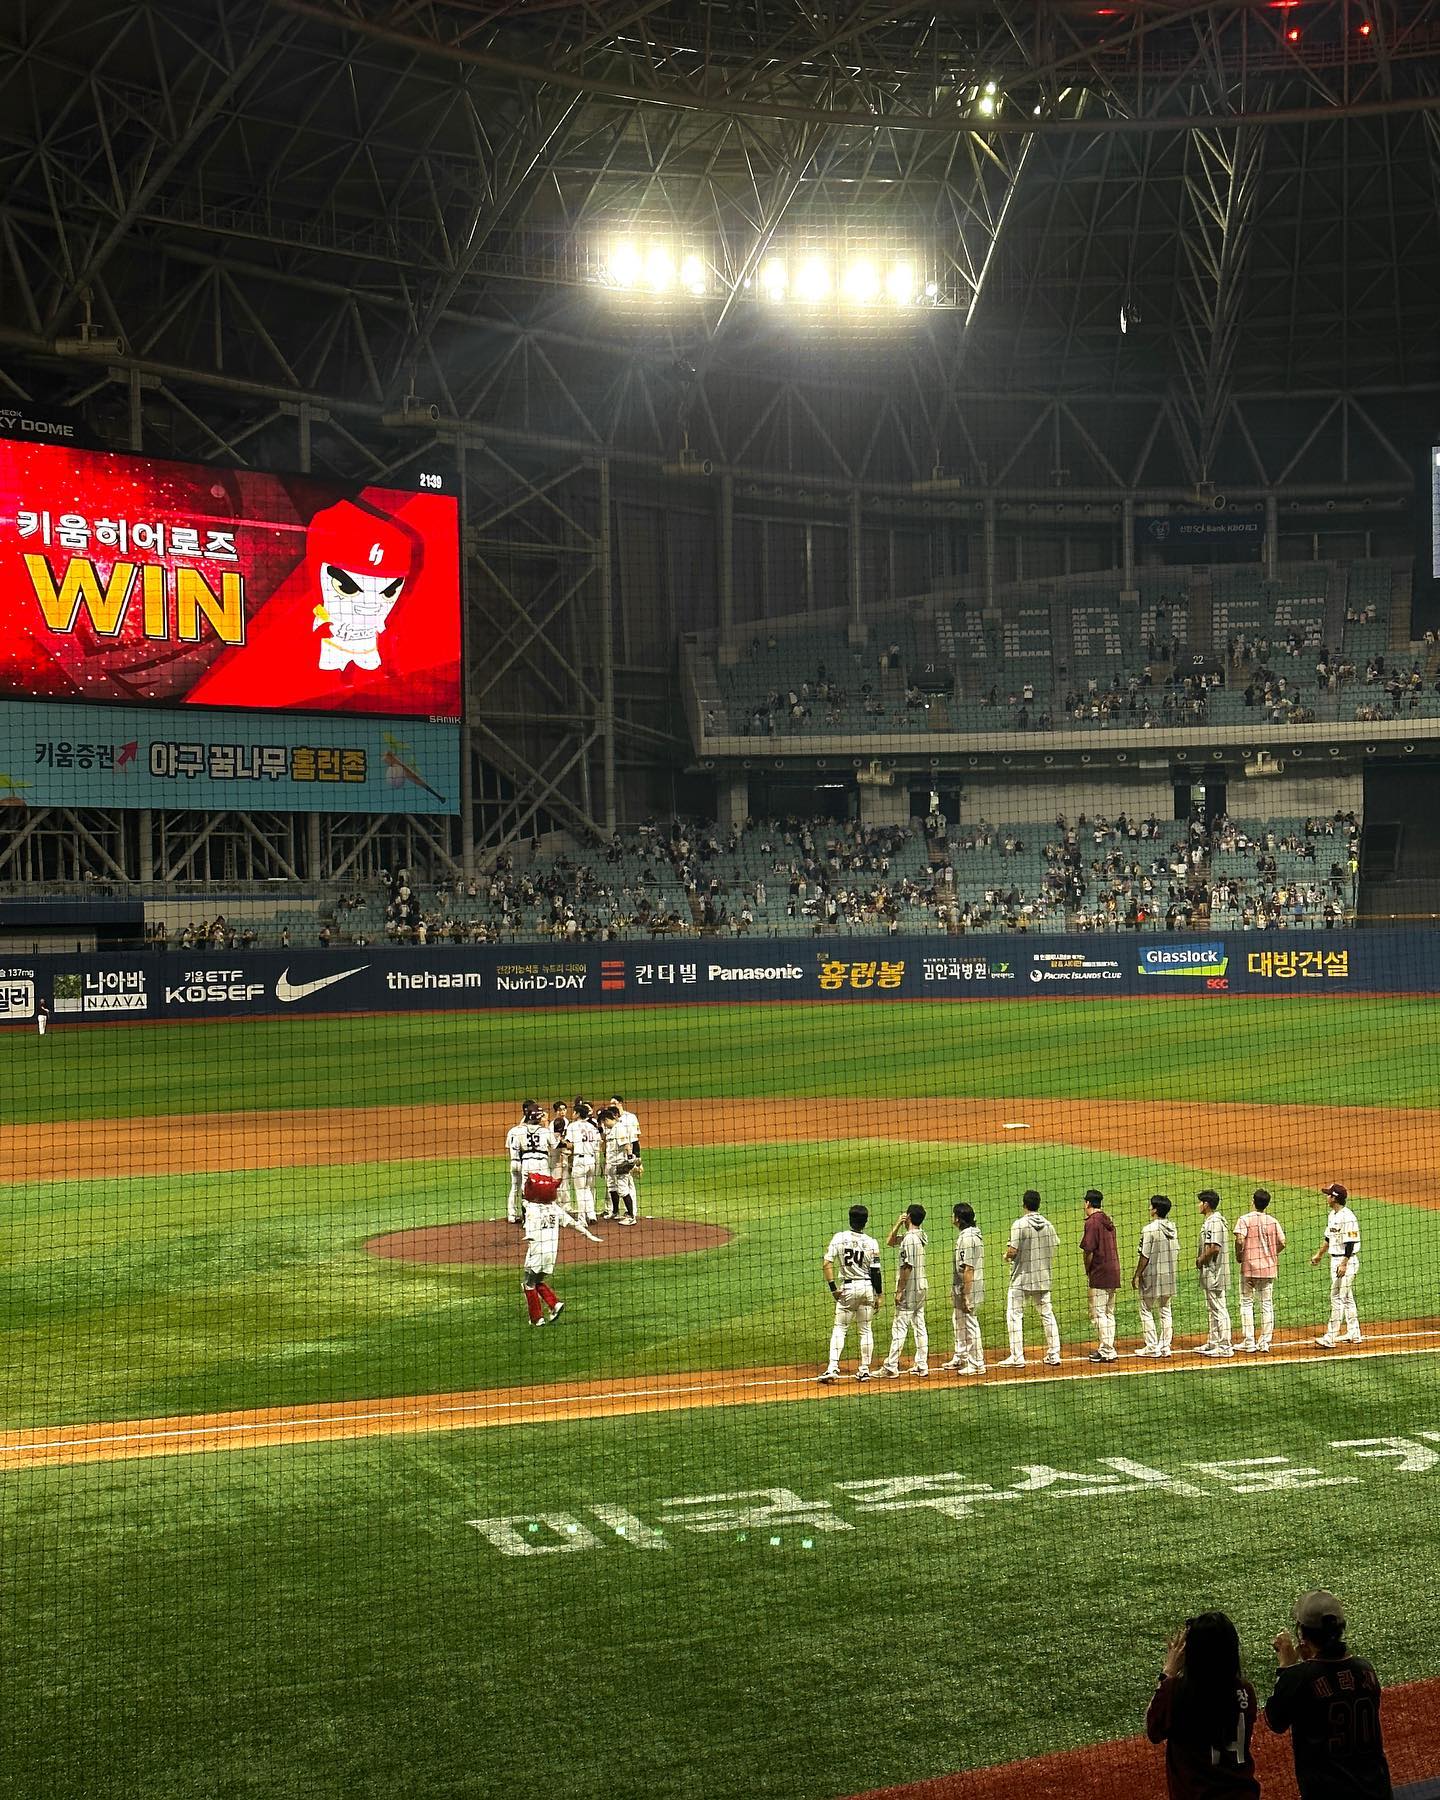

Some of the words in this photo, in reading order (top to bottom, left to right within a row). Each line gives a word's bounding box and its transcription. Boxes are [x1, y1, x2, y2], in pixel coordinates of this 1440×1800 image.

[21, 420, 75, 437] DOME
[16, 510, 240, 562] 키움히어로즈
[23, 553, 247, 647] WIN
[925, 663, 935, 673] 21
[1193, 655, 1204, 665] 22
[34, 741, 115, 770] 키움증권
[149, 741, 205, 779] 야구
[207, 743, 288, 780] 꿈나무
[290, 746, 367, 782] 홈런존
[1146, 950, 1219, 964] Glasslock
[1247, 949, 1350, 979] 대방건설
[8, 968, 35, 978] 137mg
[86, 970, 146, 994] 나아바
[708, 963, 803, 981] Panasonic
[817, 960, 905, 990] 홈런볼
[923, 963, 987, 981] 김안과병원
[165, 983, 265, 1003] KOSEF
[843, 1248, 864, 1268] 24
